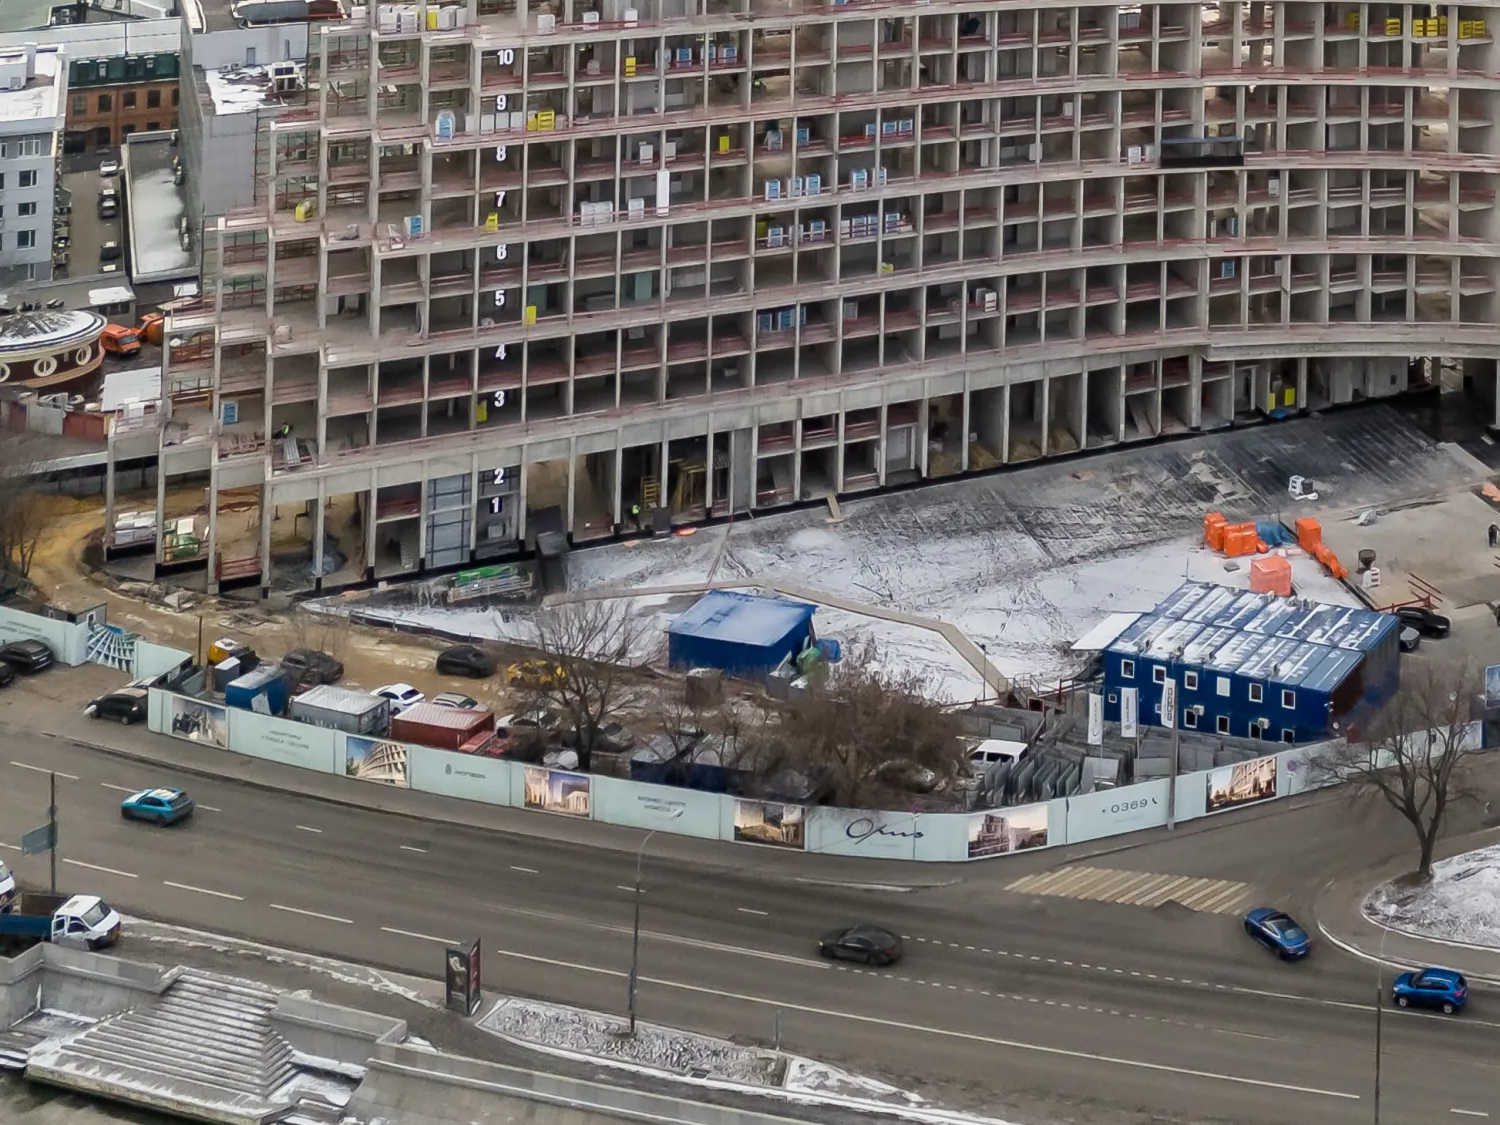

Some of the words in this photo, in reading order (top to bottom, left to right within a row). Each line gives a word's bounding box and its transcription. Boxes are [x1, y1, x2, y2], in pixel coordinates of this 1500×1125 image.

[497, 49, 514, 65] 10
[496, 94, 507, 111] 9
[496, 145, 507, 162] 8
[495, 191, 506, 207] 7
[496, 244, 507, 260] 6
[494, 290, 505, 306] 5
[495, 343, 506, 360] 4
[494, 390, 505, 407] 3
[493, 467, 505, 484] 2
[491, 497, 500, 513] 1
